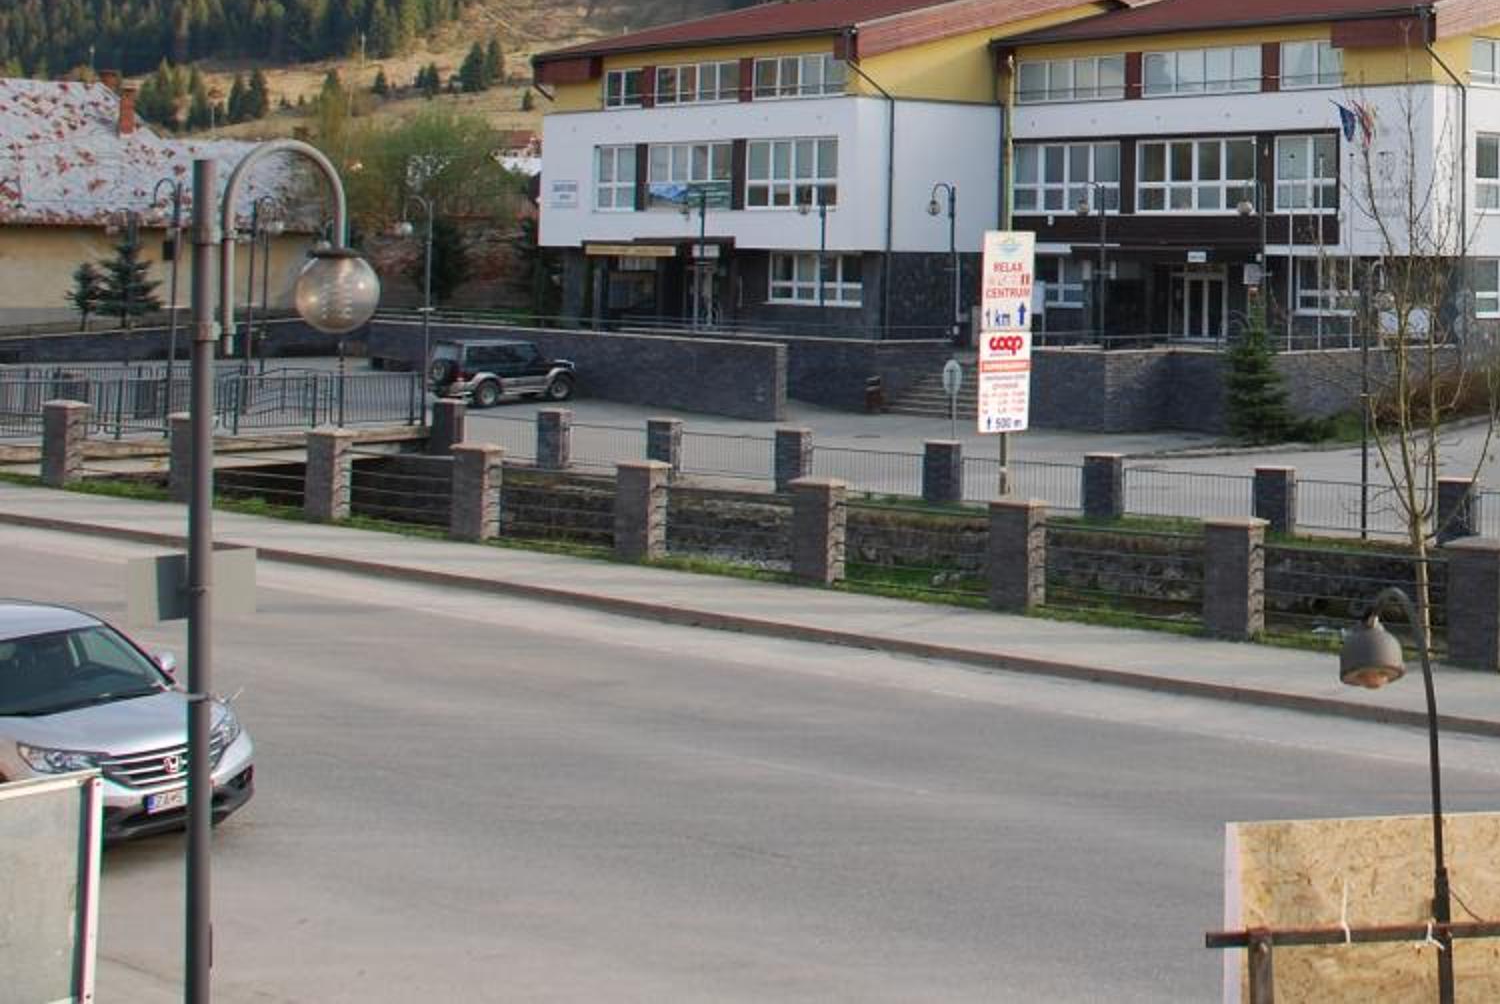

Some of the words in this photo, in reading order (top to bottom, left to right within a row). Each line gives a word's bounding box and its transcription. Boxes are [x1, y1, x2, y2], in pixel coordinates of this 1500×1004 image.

[993, 261, 1024, 272] RELAX
[986, 287, 1030, 299] CENTRUM
[995, 309, 1011, 326] km
